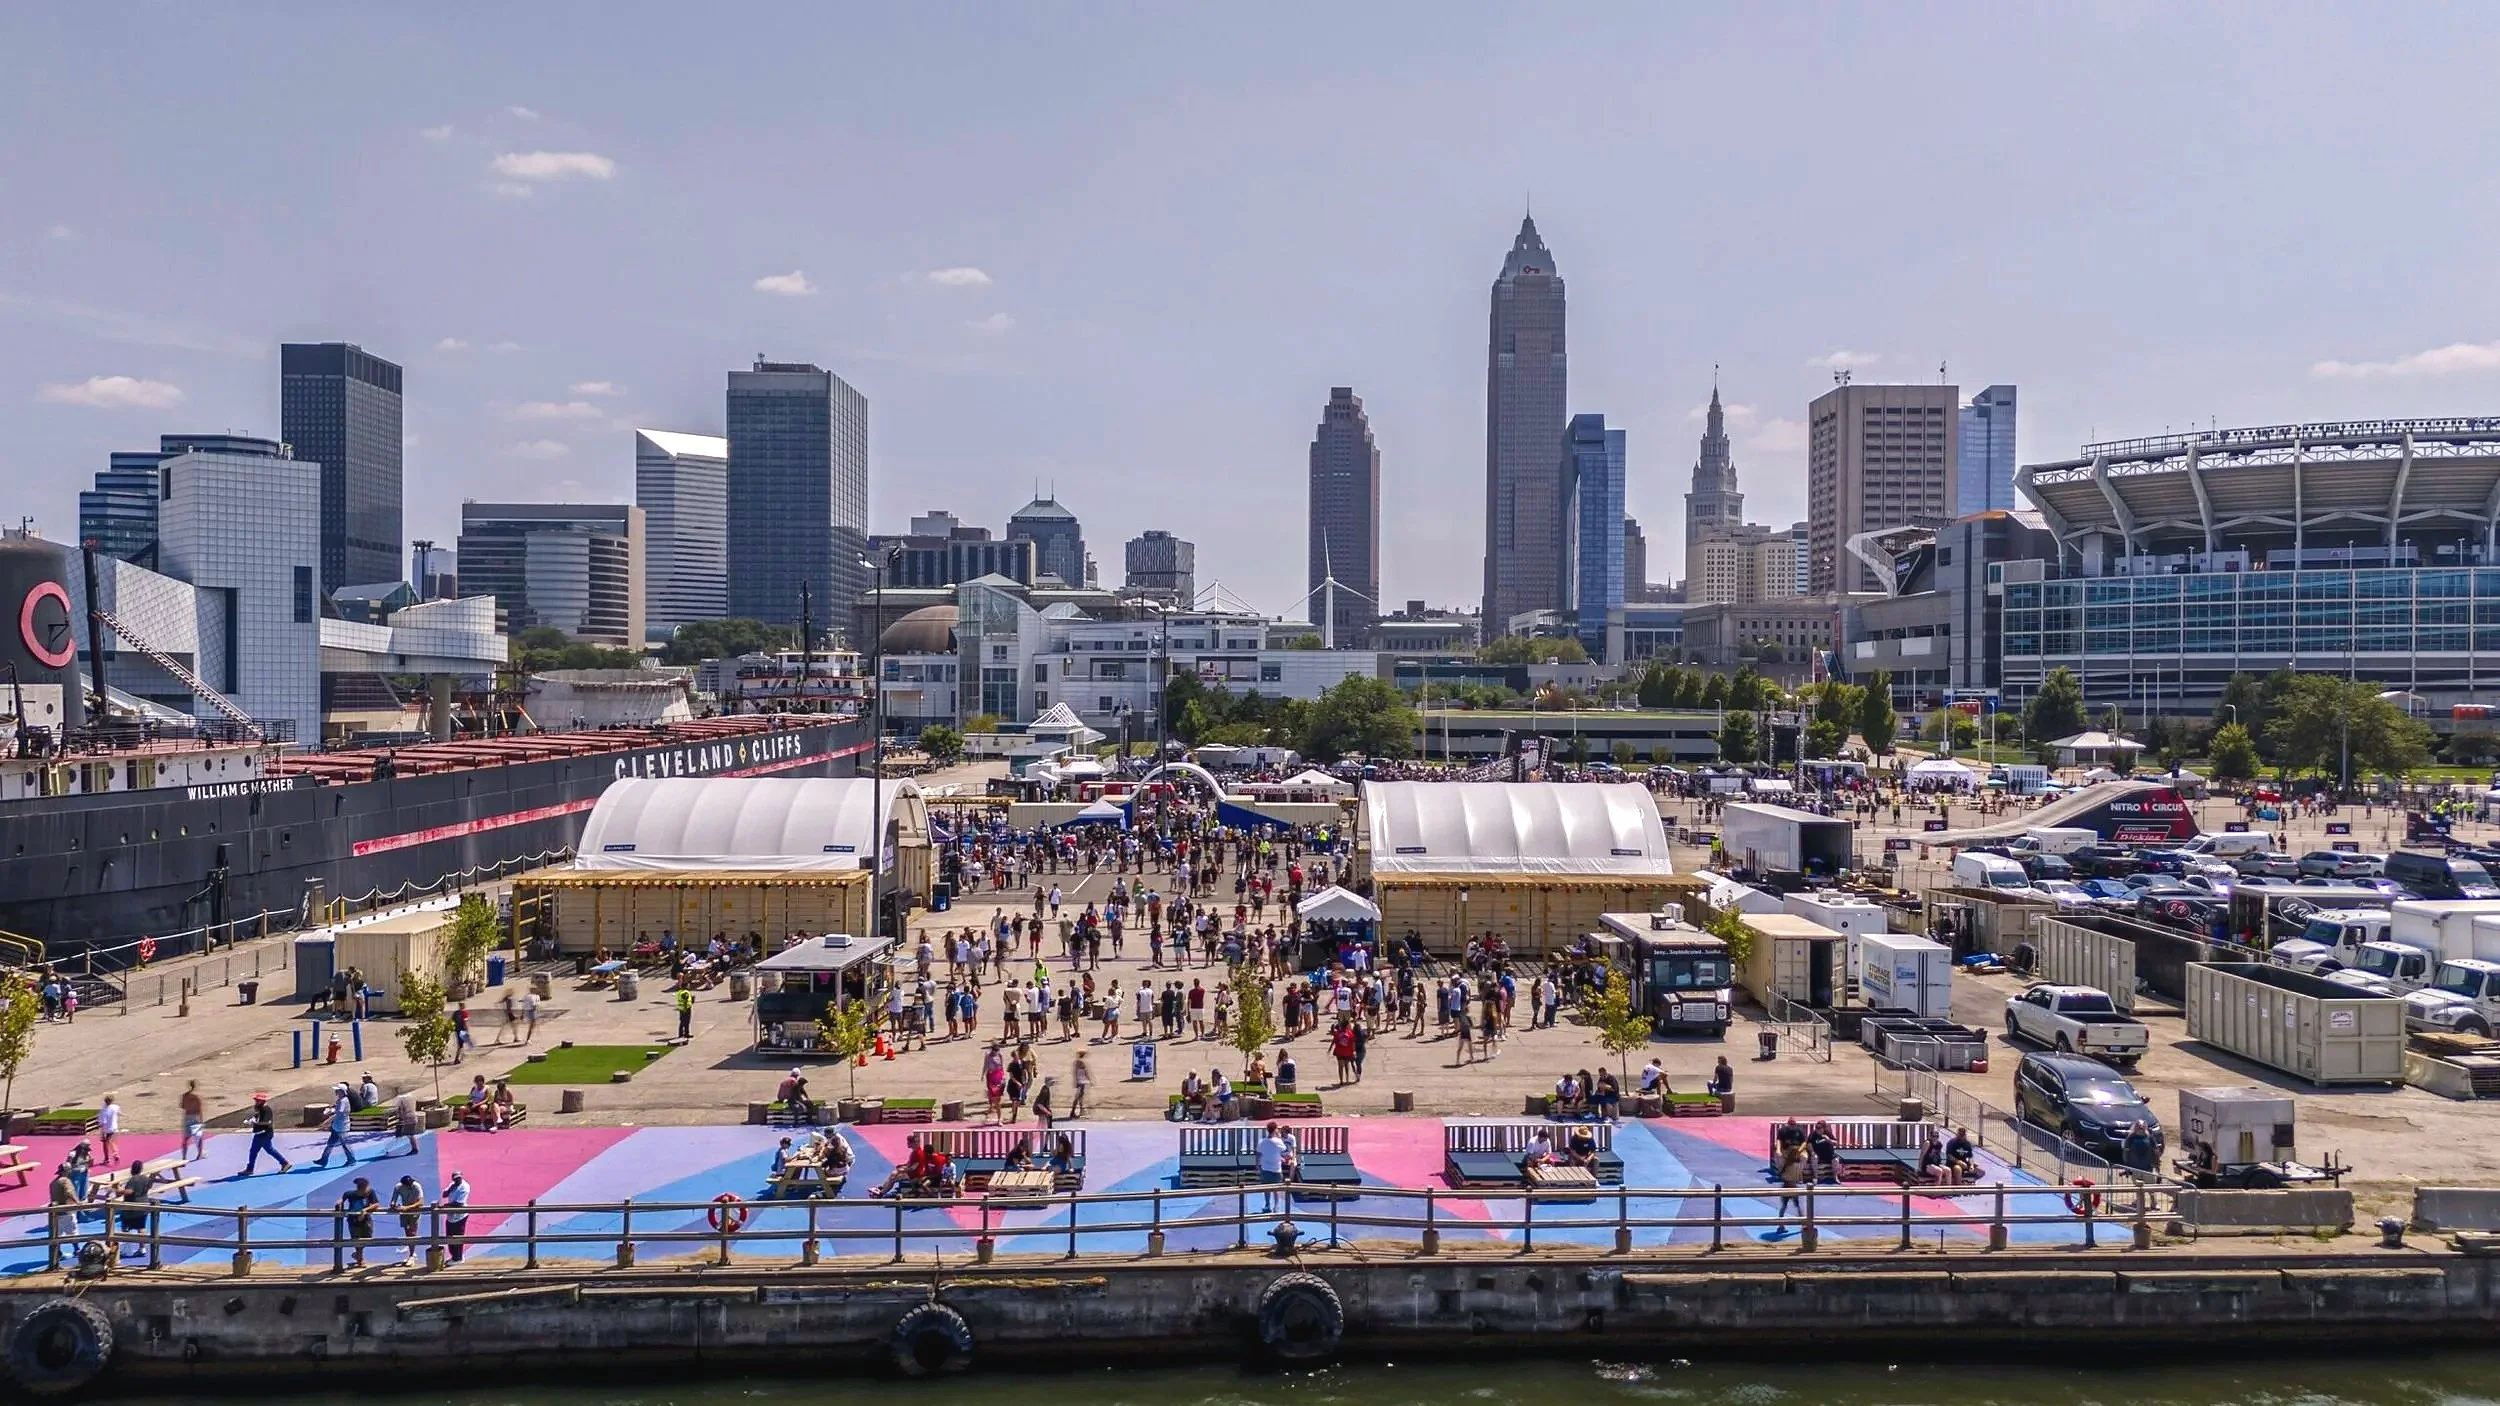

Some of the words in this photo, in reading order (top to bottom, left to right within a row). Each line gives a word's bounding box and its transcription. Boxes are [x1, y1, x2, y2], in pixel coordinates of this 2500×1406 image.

[615, 744, 733, 780] CLEVELAND
[752, 734, 801, 762] CLIFFS
[187, 784, 237, 800] WILLIAM
[251, 779, 293, 794] MATHER
[2110, 803, 2140, 811] NITRO
[2152, 803, 2183, 811] CIRCUS
